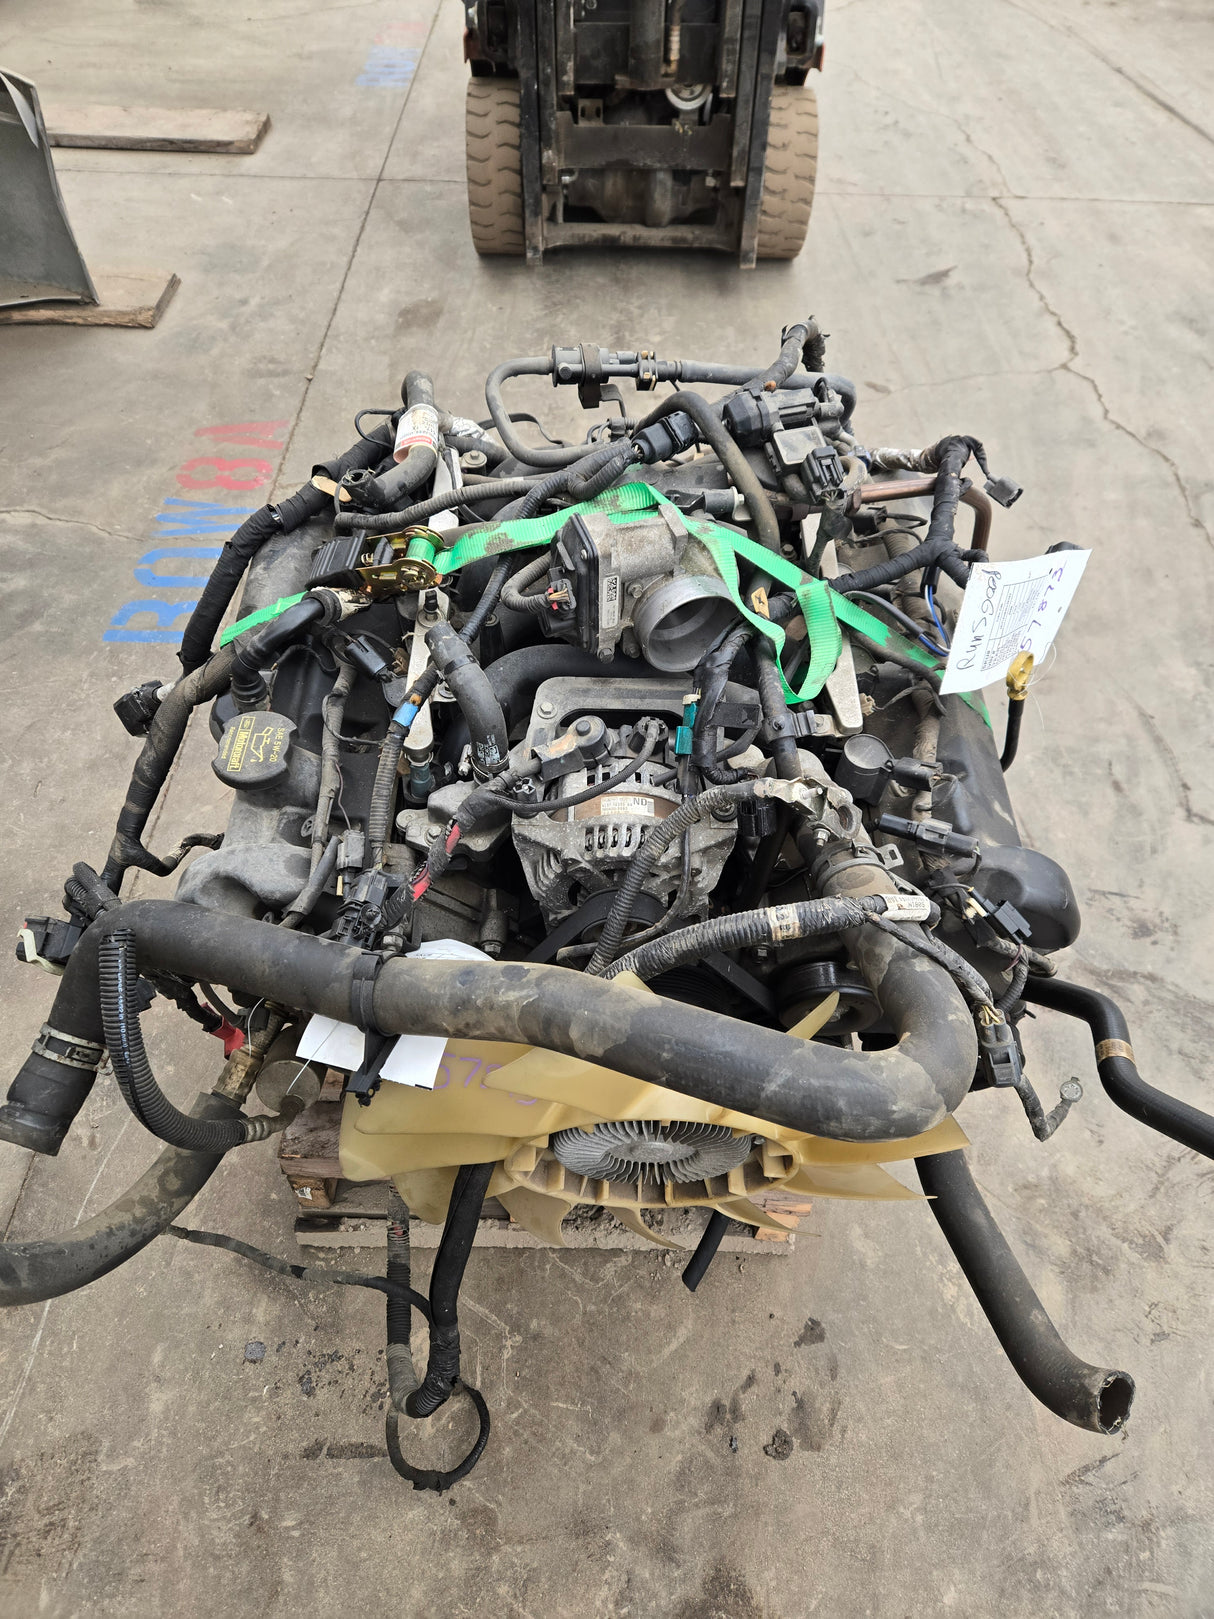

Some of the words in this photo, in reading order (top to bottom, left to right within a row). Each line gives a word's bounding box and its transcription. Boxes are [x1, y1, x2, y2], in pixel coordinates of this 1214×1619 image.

[175, 420, 289, 491] 8A
[102, 497, 257, 644] ROW
[275, 727, 286, 740] SAE
[229, 731, 250, 770] Motorcraft
[269, 741, 282, 763] 5W-20
[633, 797, 648, 807] ND
